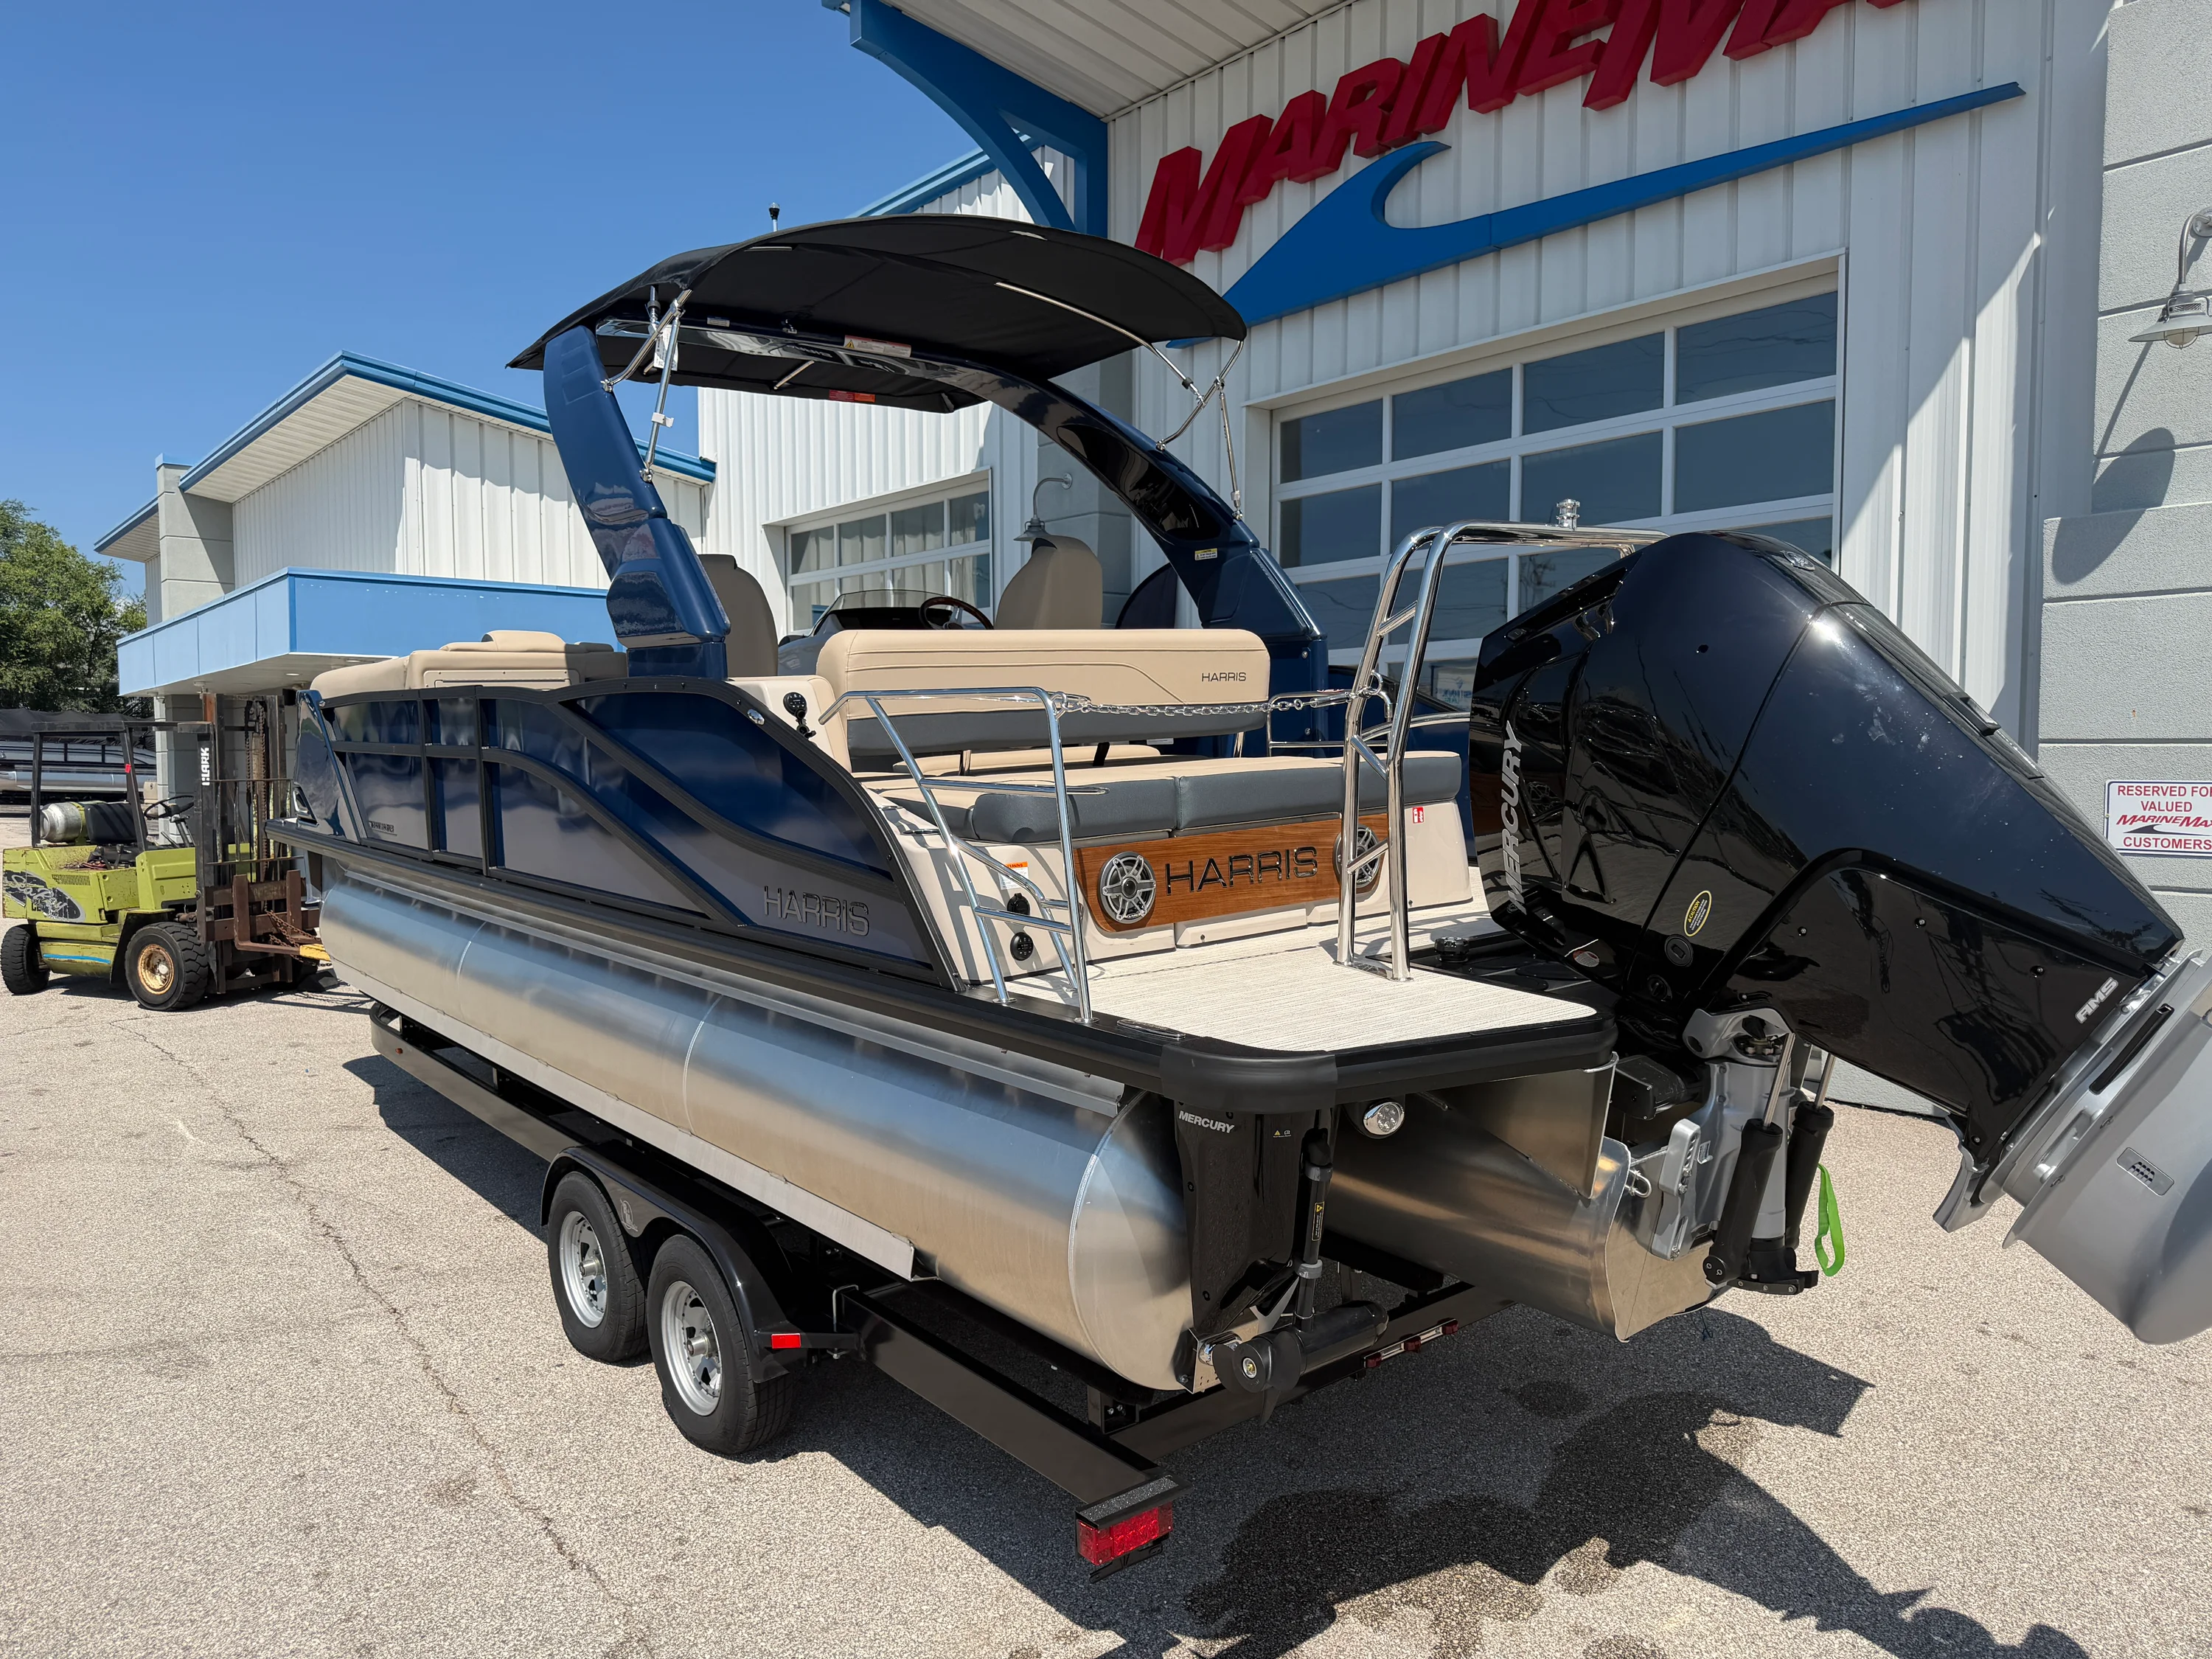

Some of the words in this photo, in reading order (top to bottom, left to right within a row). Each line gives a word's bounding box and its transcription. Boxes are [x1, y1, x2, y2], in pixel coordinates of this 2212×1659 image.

[1201, 672, 1246, 682] HARRIS
[201, 747, 210, 786] CLARK
[2118, 785, 2187, 797] RESERVED
[1500, 720, 1528, 916] MERCURY
[2141, 801, 2193, 813] VALUED
[2124, 837, 2212, 850] CUSTOMERS
[1166, 846, 1318, 896] HARRIS
[764, 886, 869, 936] HARRIS
[2075, 977, 2118, 1024] AMS
[1178, 1110, 1234, 1134] MERCURY
